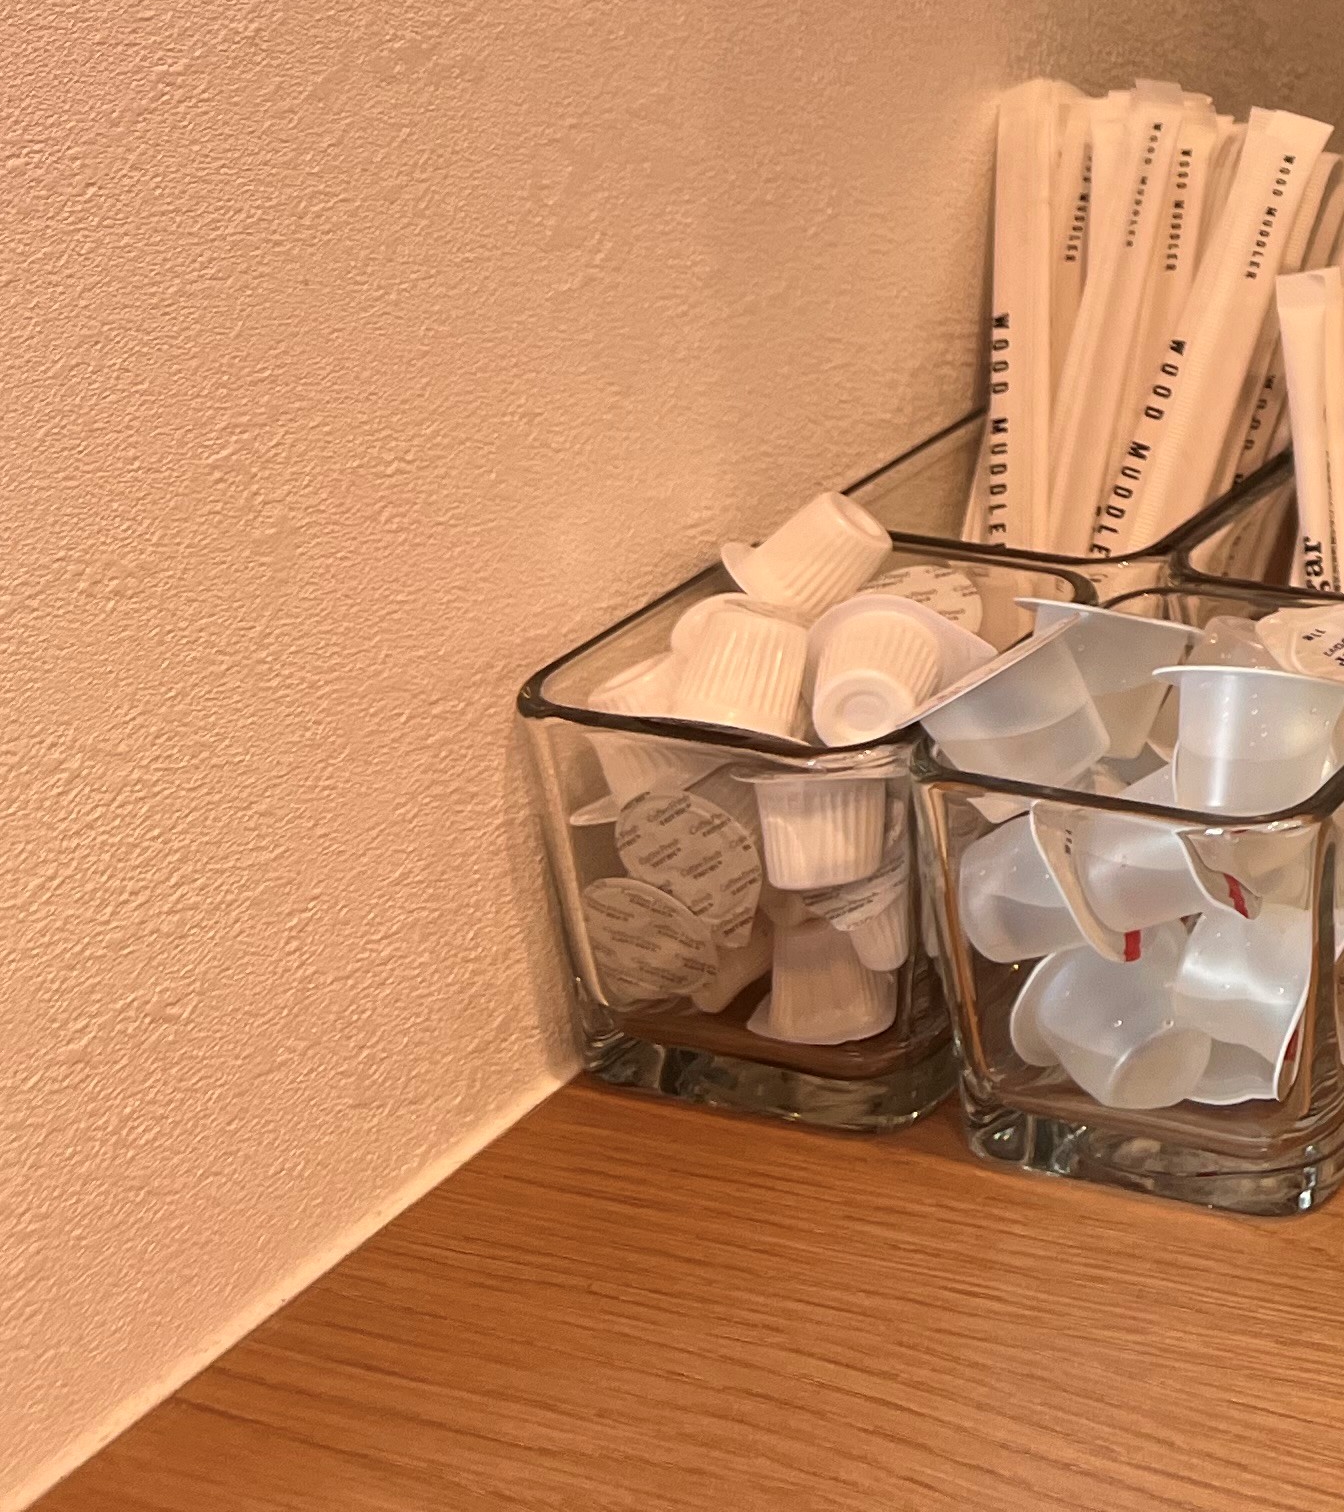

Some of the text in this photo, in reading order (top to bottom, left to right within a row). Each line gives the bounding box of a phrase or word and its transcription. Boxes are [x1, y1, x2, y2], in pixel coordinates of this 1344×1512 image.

[1244, 153, 1296, 280] WOOD MUDDLER
[988, 312, 1010, 548] WOOD MUDDLE
[1144, 338, 1187, 421] WOOD
